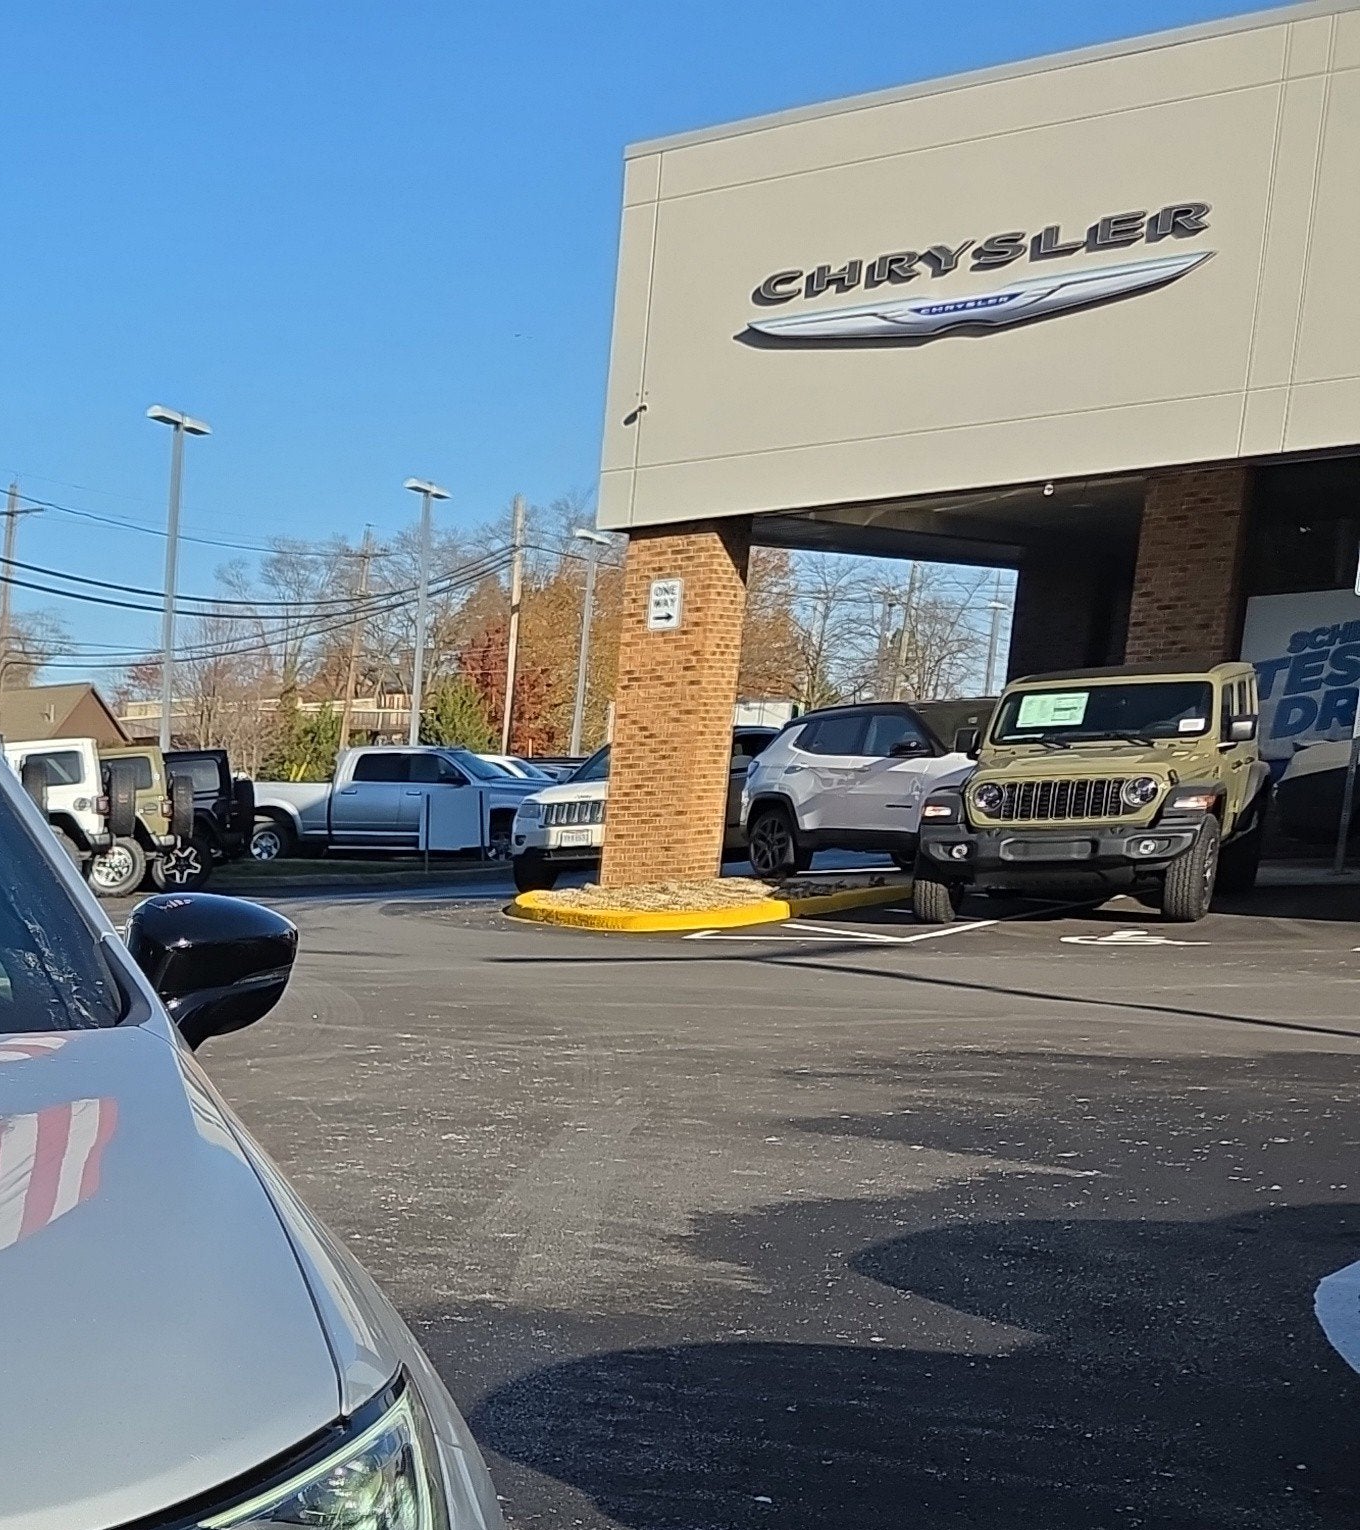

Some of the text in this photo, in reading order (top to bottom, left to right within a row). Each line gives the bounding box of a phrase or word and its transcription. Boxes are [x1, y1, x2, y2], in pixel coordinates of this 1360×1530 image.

[751, 202, 1212, 306] CHRYSLER
[653, 584, 678, 597] ONE
[653, 598, 677, 608] WAY
